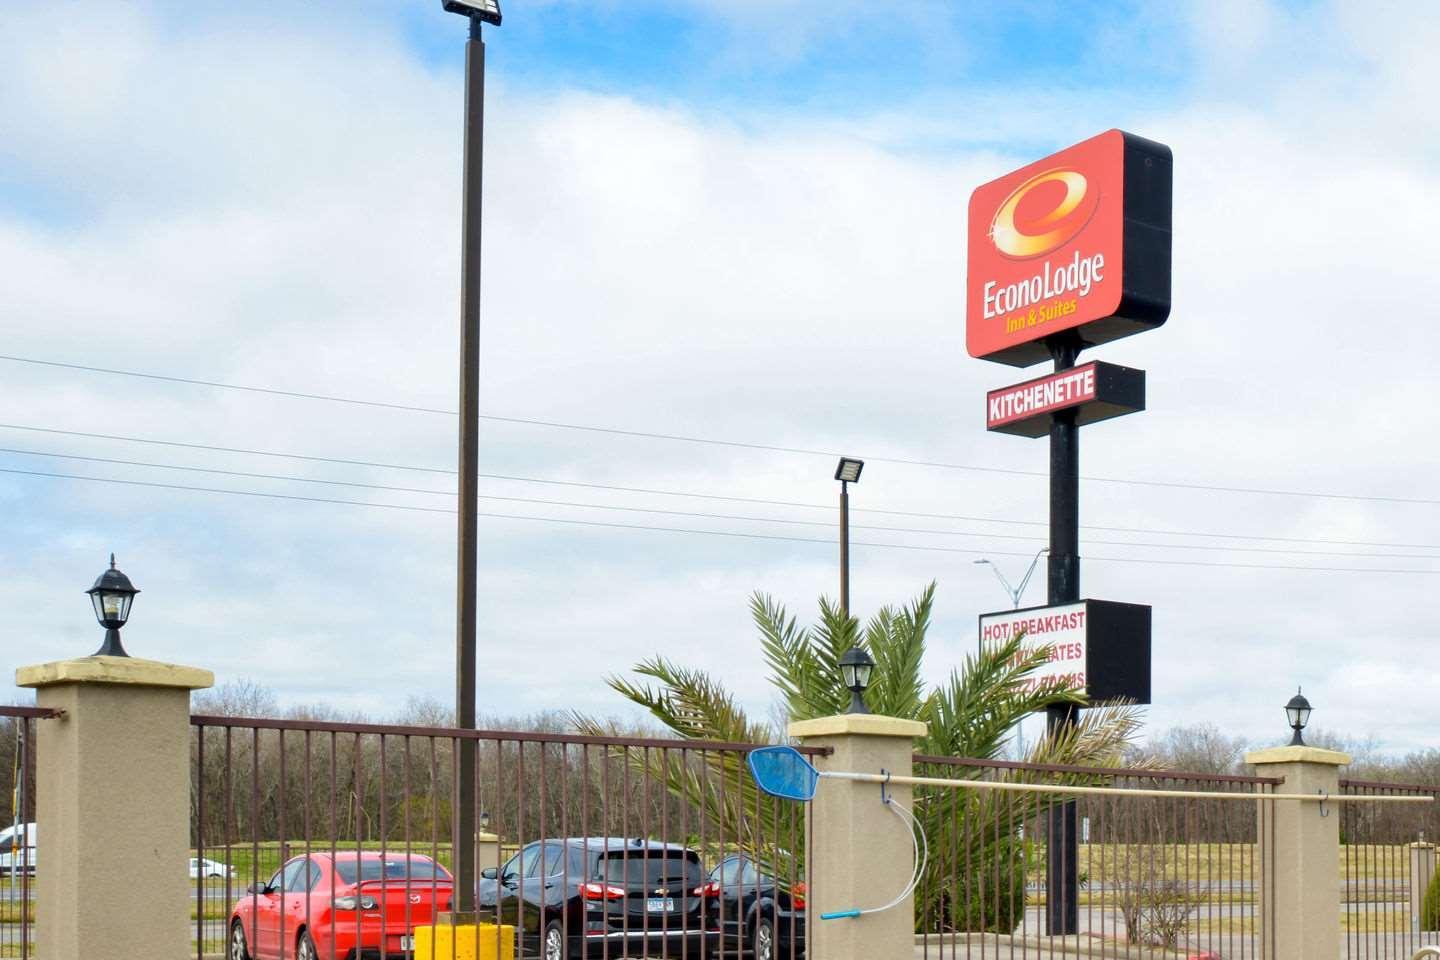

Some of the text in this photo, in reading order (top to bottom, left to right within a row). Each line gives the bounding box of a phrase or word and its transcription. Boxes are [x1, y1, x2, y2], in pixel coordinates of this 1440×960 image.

[983, 250, 1105, 319] EconoLodge
[1006, 298, 1077, 334] Inn & Suites
[989, 368, 1095, 421] KITCHENETTE
[984, 611, 1085, 640] HOT BREAKFAST
